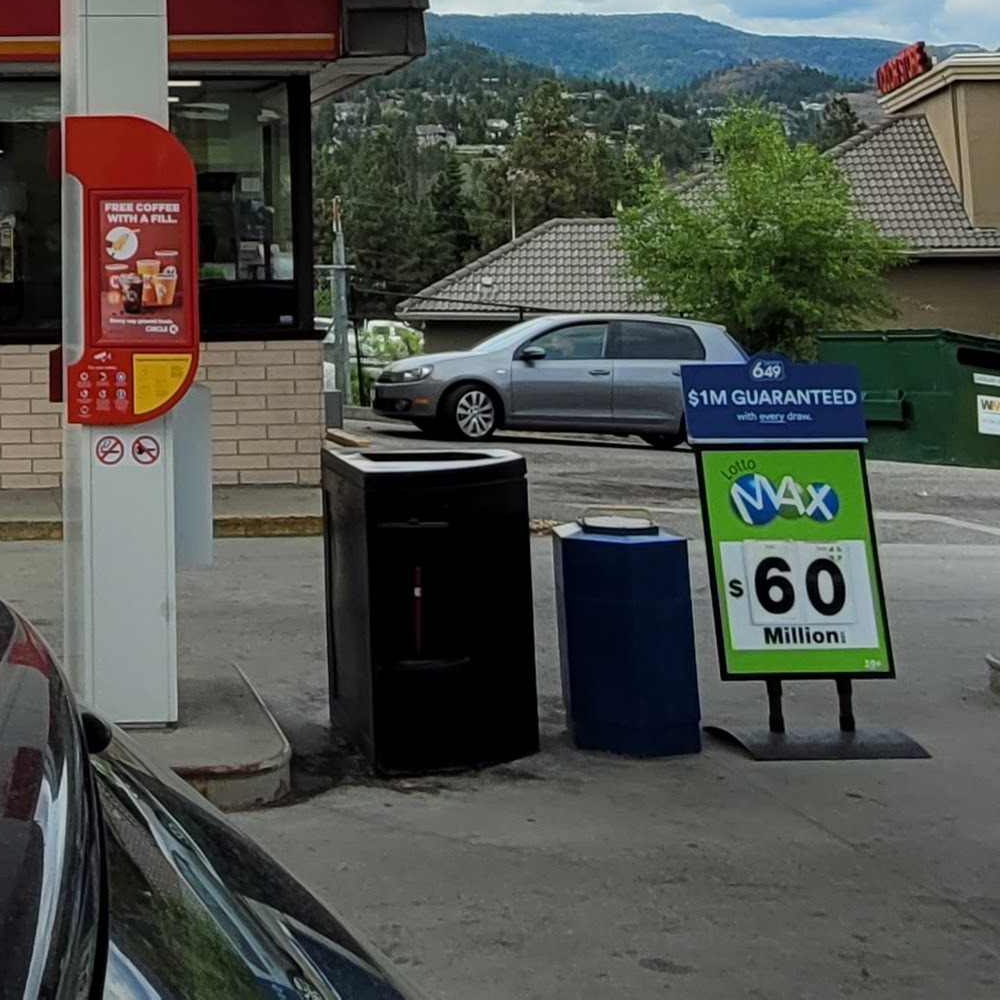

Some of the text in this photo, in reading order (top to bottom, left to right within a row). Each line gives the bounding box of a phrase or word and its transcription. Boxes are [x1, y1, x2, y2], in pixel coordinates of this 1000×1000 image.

[105, 203, 180, 213] FREE COFFEE
[107, 214, 178, 224] WITH A FILL.
[751, 361, 782, 379] 649
[687, 389, 858, 408] $1M GUARANTEED
[737, 411, 813, 423] with every draw.
[720, 459, 757, 481] Lotto
[730, 473, 834, 525] MAX
[728, 556, 847, 617] $ 60
[763, 627, 840, 645] Million
